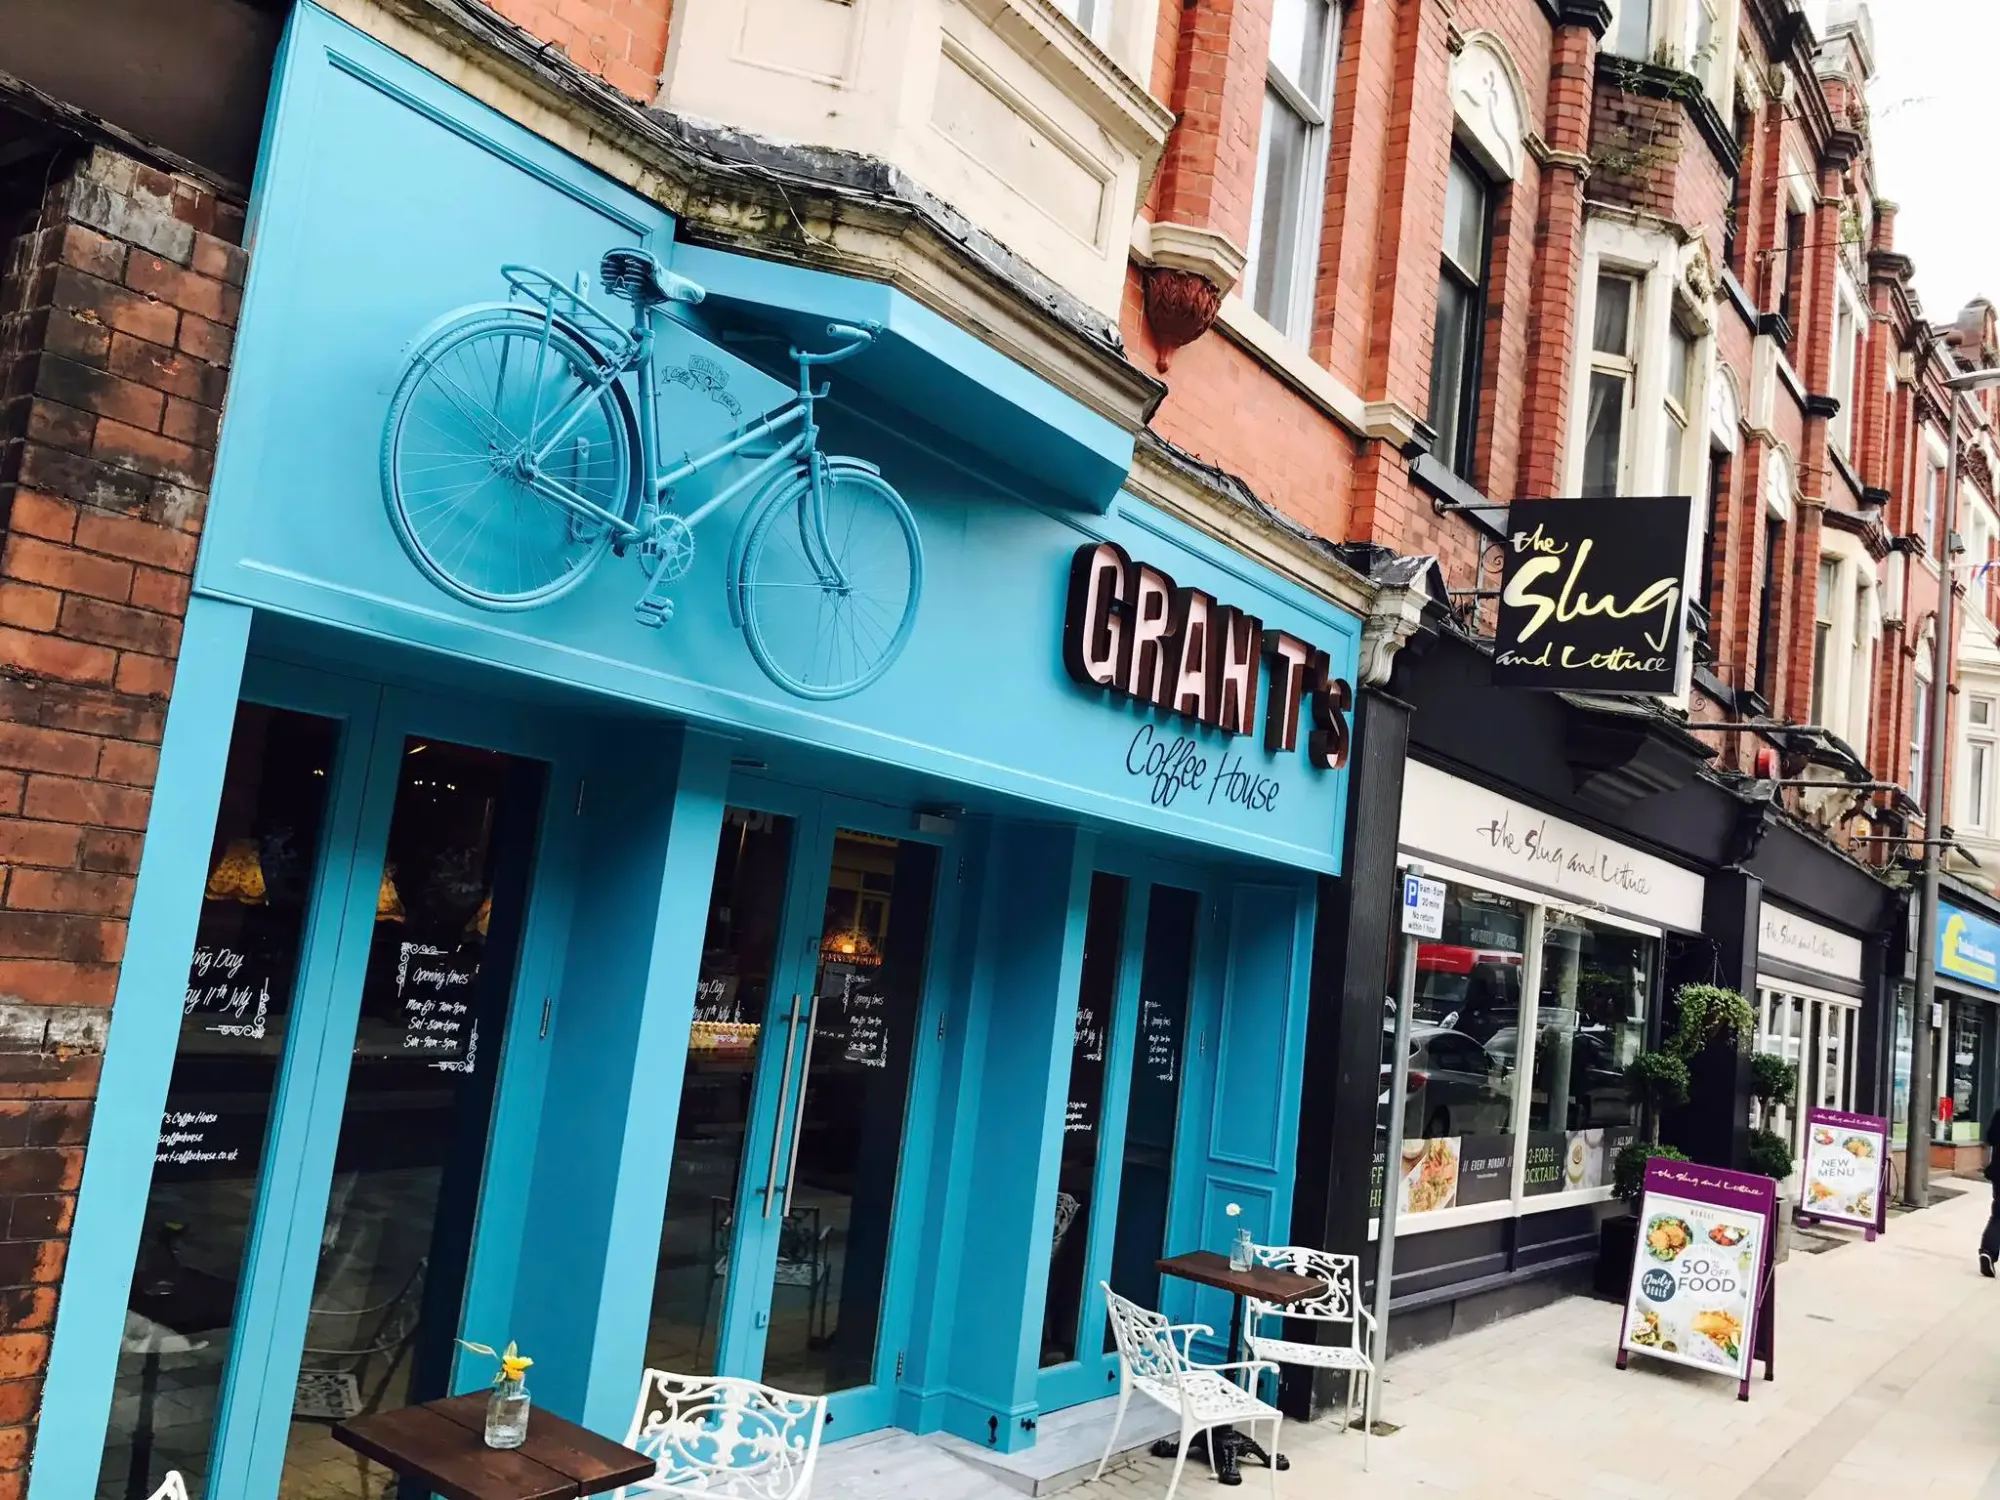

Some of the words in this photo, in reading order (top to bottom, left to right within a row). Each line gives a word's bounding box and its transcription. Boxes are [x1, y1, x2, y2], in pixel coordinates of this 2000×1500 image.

[1509, 523, 1569, 554] the
[1503, 538, 1680, 652] Slug
[1495, 641, 1552, 667] and
[1561, 645, 1671, 672] Lettuce
[1126, 724, 1206, 808] Coffee
[1208, 752, 1280, 812] House
[1476, 810, 1521, 854] the
[1525, 820, 1563, 883] Slug
[1567, 845, 1597, 879] and
[1602, 854, 1651, 895] Lettuce
[1407, 881, 1417, 904] P
[1412, 910, 1420, 920] No
[1420, 913, 1434, 922] return
[1408, 922, 1422, 931] within
[1426, 924, 1437, 933] hour
[213, 948, 245, 979] Day
[412, 965, 446, 990] Opening
[708, 979, 726, 1001] Day
[184, 985, 202, 1015] ay
[203, 984, 228, 1006] 11th
[219, 985, 253, 1019] July
[172, 1111, 196, 1128] Coffee
[194, 1111, 218, 1124] House
[1471, 1159, 1485, 1171] EVERY
[1818, 1167, 1855, 1177] MENU
[1821, 1158, 1849, 1168] NEW
[1652, 1169, 1675, 1180] the
[1676, 1172, 1699, 1187] Slug
[1701, 1179, 1721, 1188] and
[1681, 1259, 1709, 1275] 50
[1710, 1268, 1731, 1276] OFF
[1643, 1272, 1673, 1290] Daily
[1678, 1277, 1736, 1293] FOOD
[1646, 1285, 1667, 1299] DEALS
